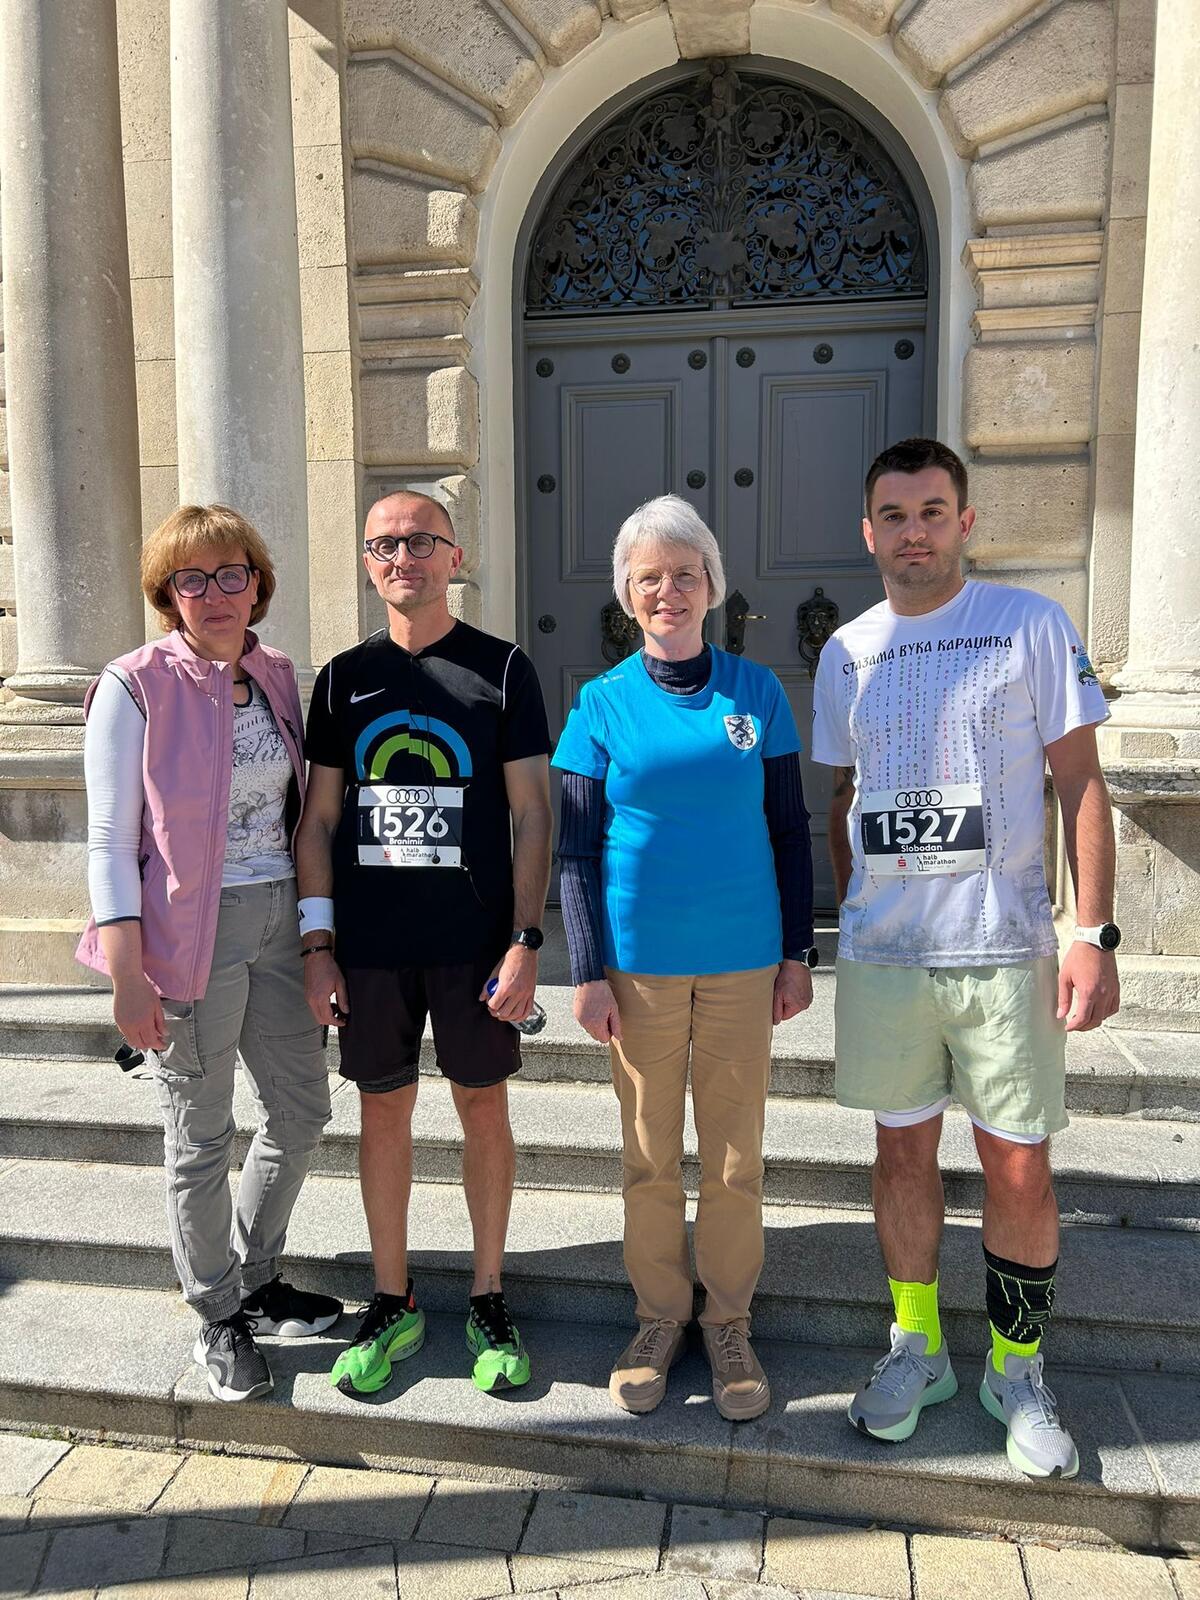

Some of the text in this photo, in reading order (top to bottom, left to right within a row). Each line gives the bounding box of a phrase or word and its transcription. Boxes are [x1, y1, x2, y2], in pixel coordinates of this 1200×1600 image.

[842, 635, 1013, 676] СТАЗАМА ВУКА КАРАЏИЋА
[369, 807, 449, 838] 1526
[876, 808, 967, 846] 1527
[901, 844, 943, 853] Slobodan
